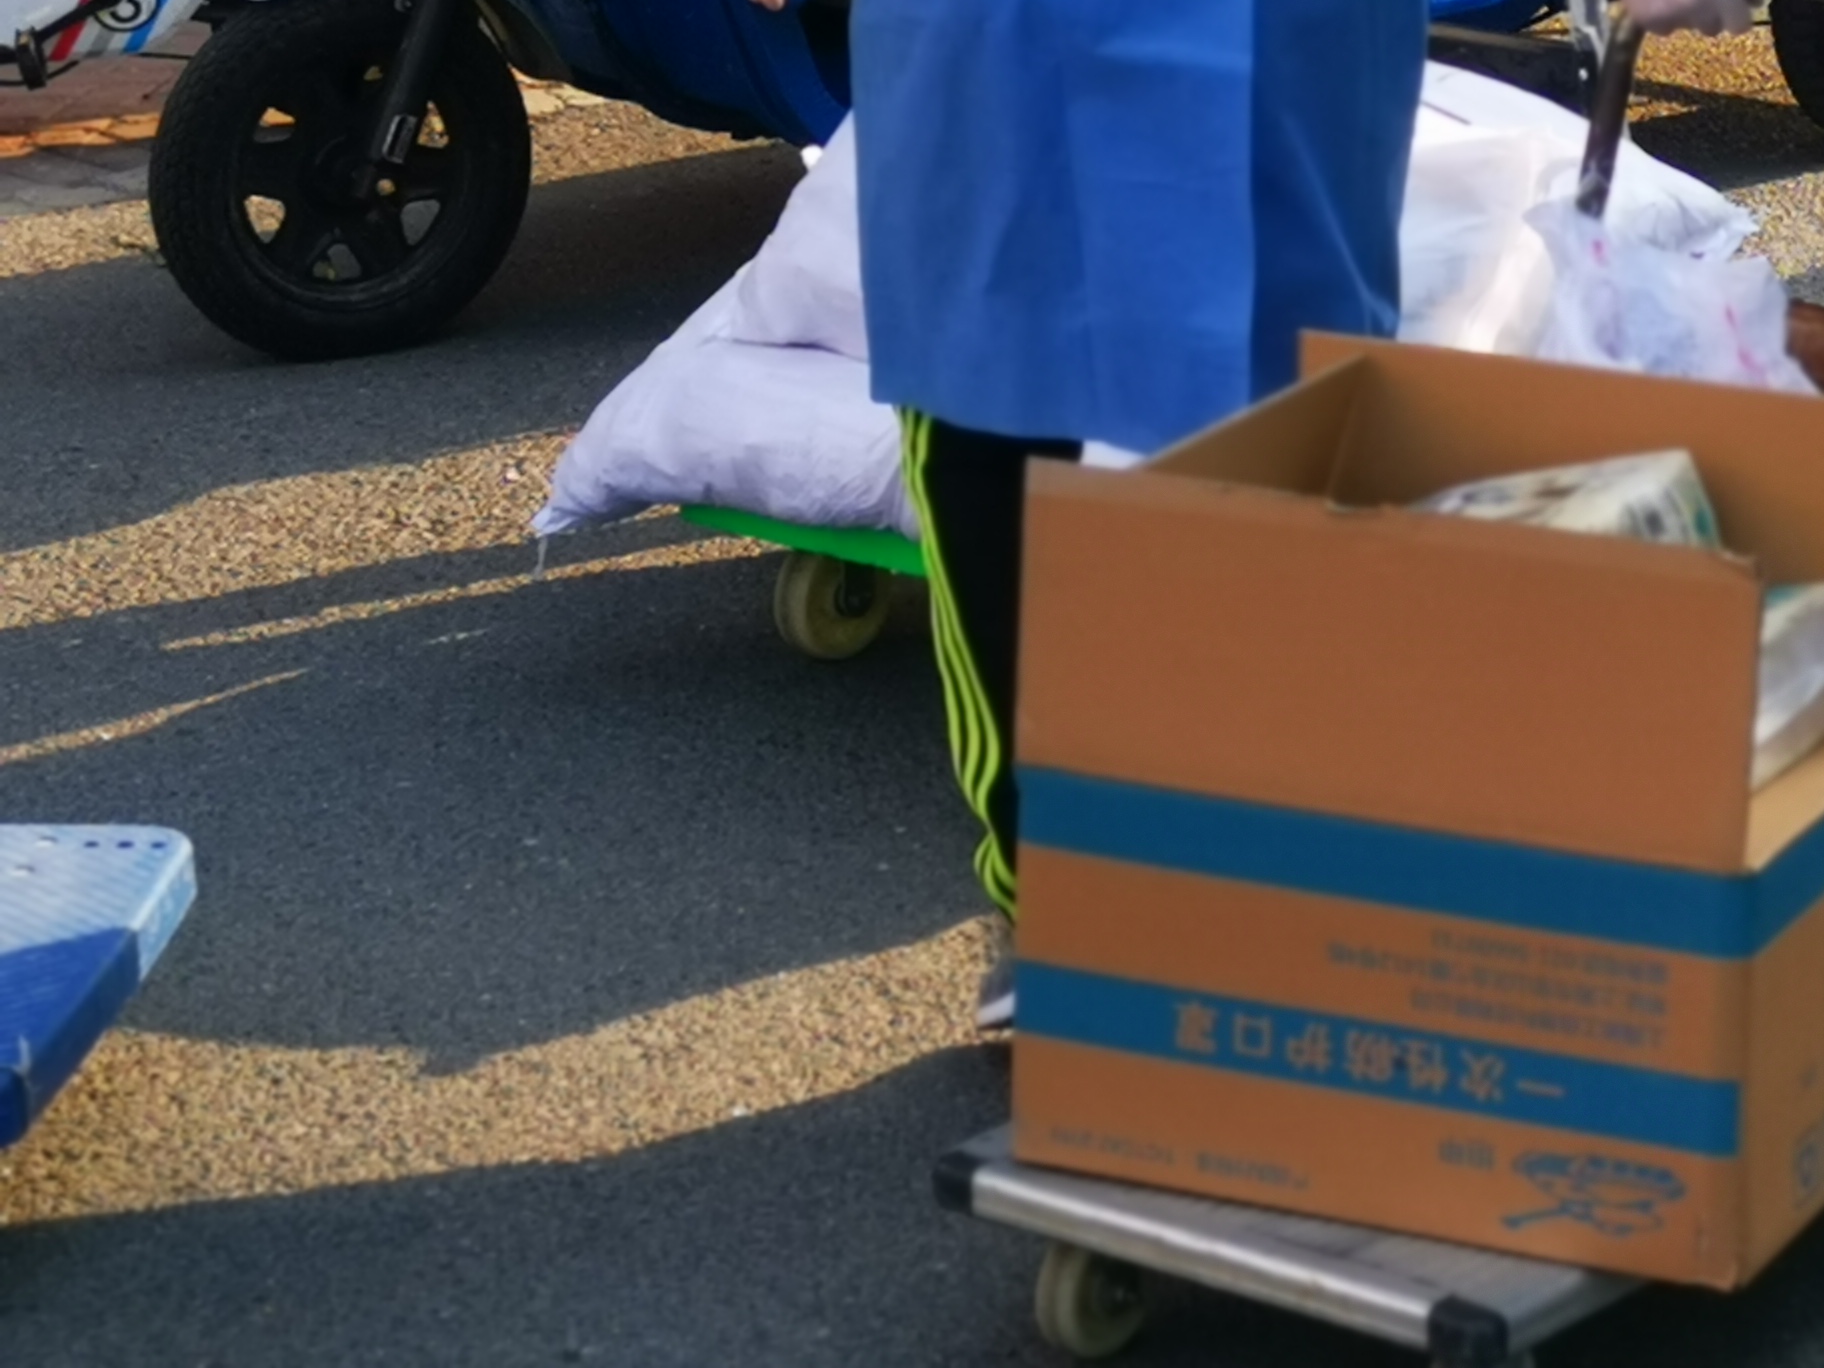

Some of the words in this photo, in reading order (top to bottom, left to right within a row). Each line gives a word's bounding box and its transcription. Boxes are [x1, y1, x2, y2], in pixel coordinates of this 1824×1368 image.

[1174, 998, 1563, 1102] 一次性防护口罩
